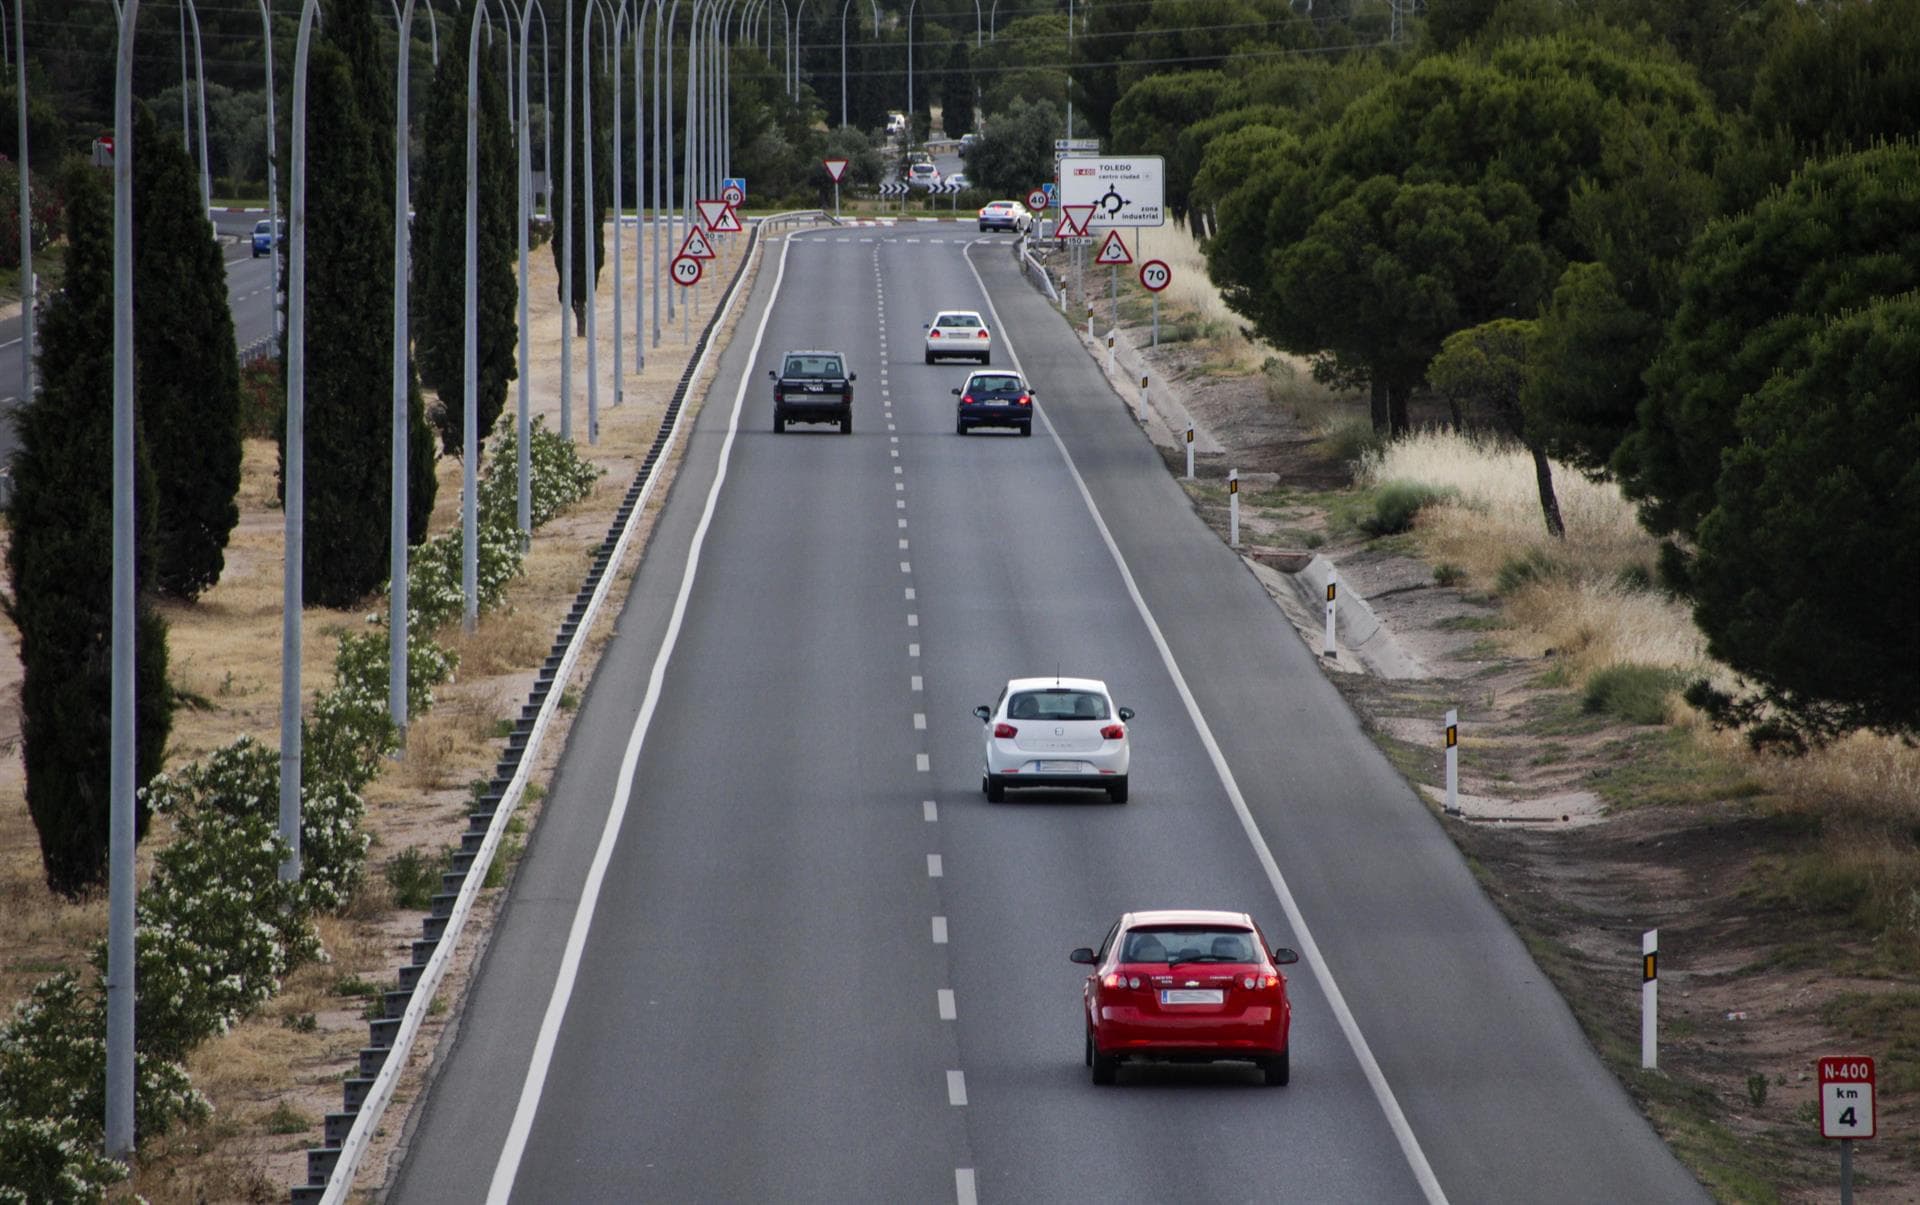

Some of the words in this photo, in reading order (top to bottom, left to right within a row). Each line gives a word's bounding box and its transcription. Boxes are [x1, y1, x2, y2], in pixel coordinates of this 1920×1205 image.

[679, 264, 696, 275] 70
[1148, 270, 1165, 280] 70
[1824, 1063, 1868, 1079] N-400
[1836, 1088, 1858, 1098] km
[1839, 1106, 1857, 1127] 4
